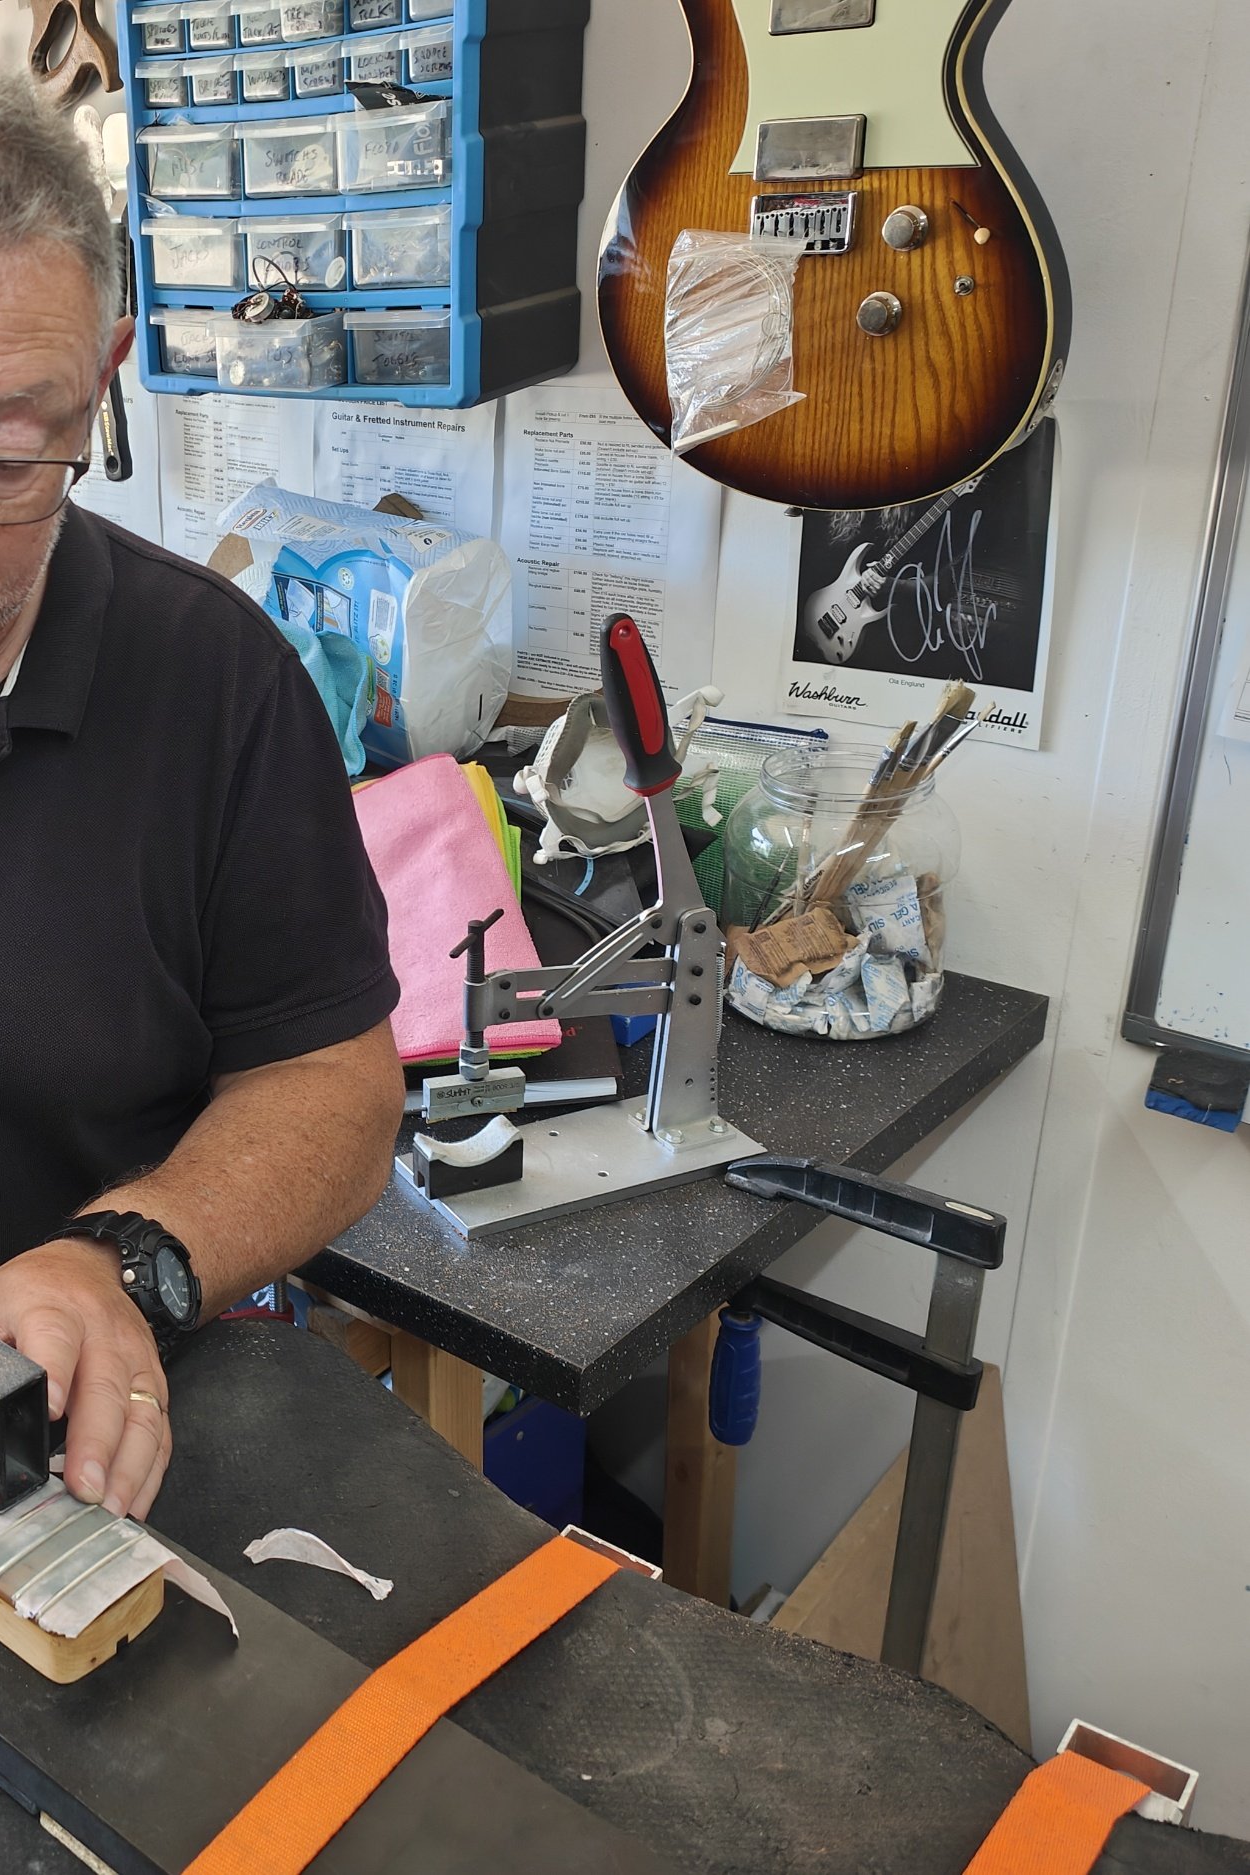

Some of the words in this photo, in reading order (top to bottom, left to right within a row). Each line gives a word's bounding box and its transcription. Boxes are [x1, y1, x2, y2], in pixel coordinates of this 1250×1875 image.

[256, 235, 304, 250] CONTROL
[331, 411, 354, 422] Guitar
[355, 414, 362, 423] &
[363, 415, 391, 425] Fretted
[393, 418, 436, 429] Instrument
[437, 421, 466, 433] Repairs
[523, 429, 558, 437] Replacement
[516, 557, 540, 566] Acoustic
[888, 677, 900, 685] Ola
[900, 679, 925, 688] Englund
[788, 680, 867, 707] Washburn
[828, 702, 857, 710] GUITARS
[889, 905, 909, 921] GEL
[445, 1087, 471, 1099] SUMMIT
